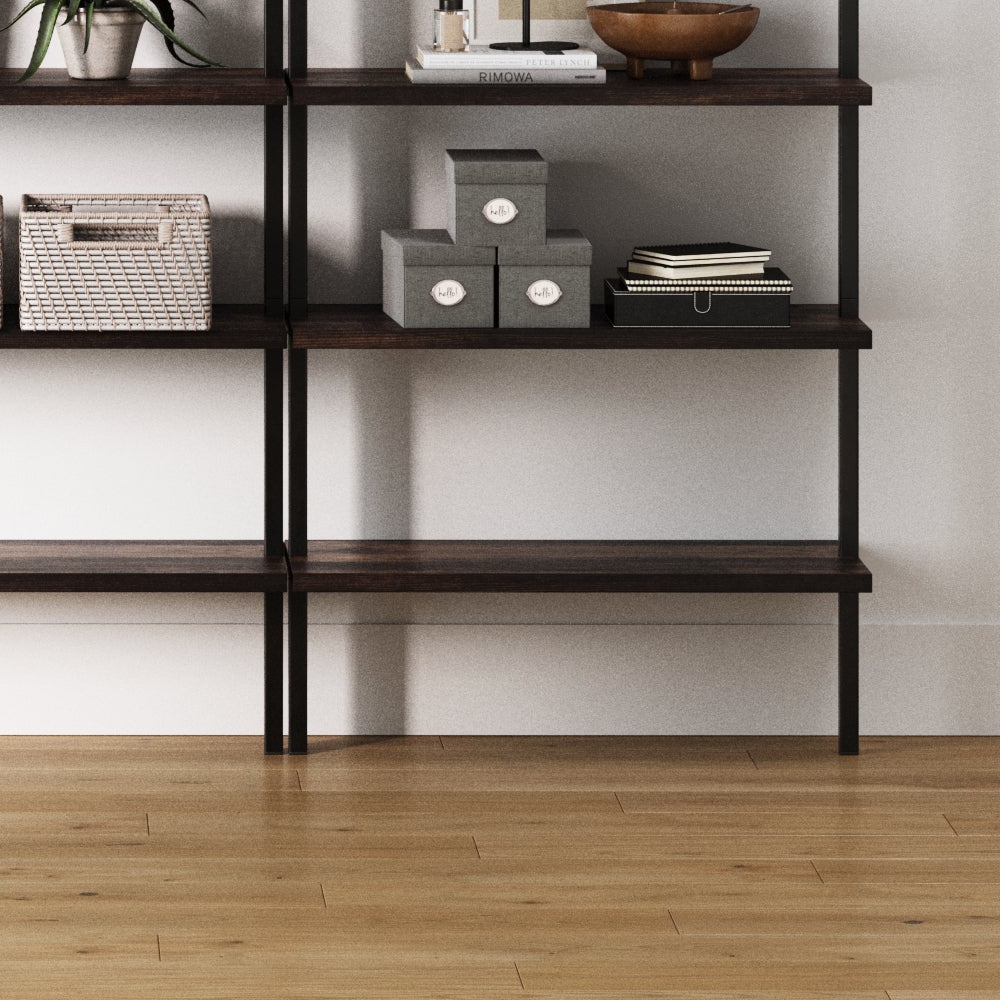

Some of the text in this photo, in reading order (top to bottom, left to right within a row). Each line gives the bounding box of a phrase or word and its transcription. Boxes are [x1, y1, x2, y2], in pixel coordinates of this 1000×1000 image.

[479, 72, 534, 83] RIMOWA
[490, 205, 510, 217] hello!
[438, 287, 458, 299] hello!
[534, 287, 554, 299] hello!
